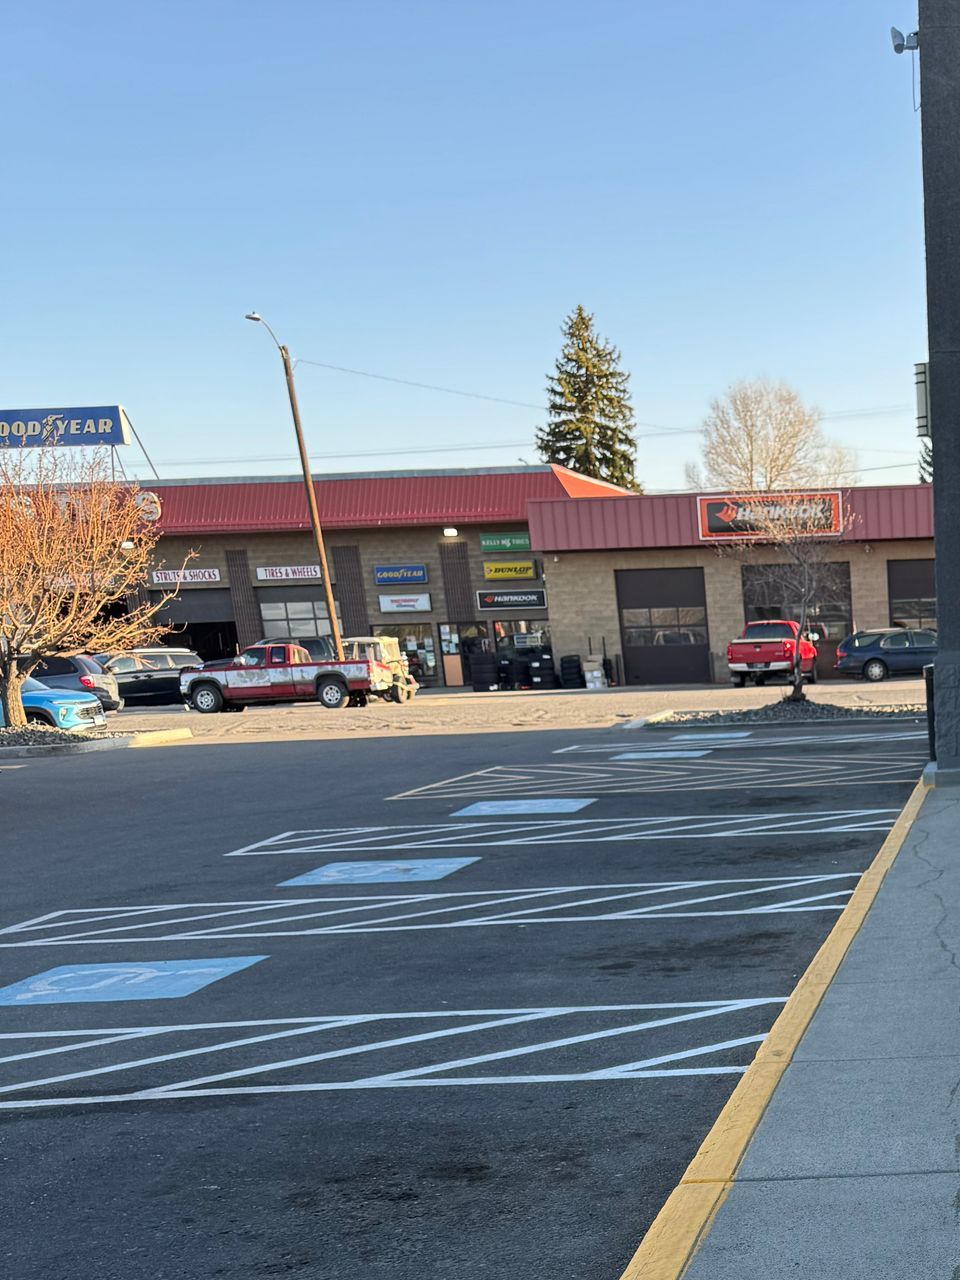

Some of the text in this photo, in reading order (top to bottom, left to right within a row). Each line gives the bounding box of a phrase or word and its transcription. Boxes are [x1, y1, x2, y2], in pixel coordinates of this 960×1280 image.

[0, 418, 114, 438] OODYEAR
[155, 570, 181, 583] STRUTS
[188, 569, 217, 582] SHOCKS
[264, 565, 318, 579] TIRES & WHEELS
[376, 568, 424, 580] GOODYEAR
[493, 566, 533, 575] DUNLOP
